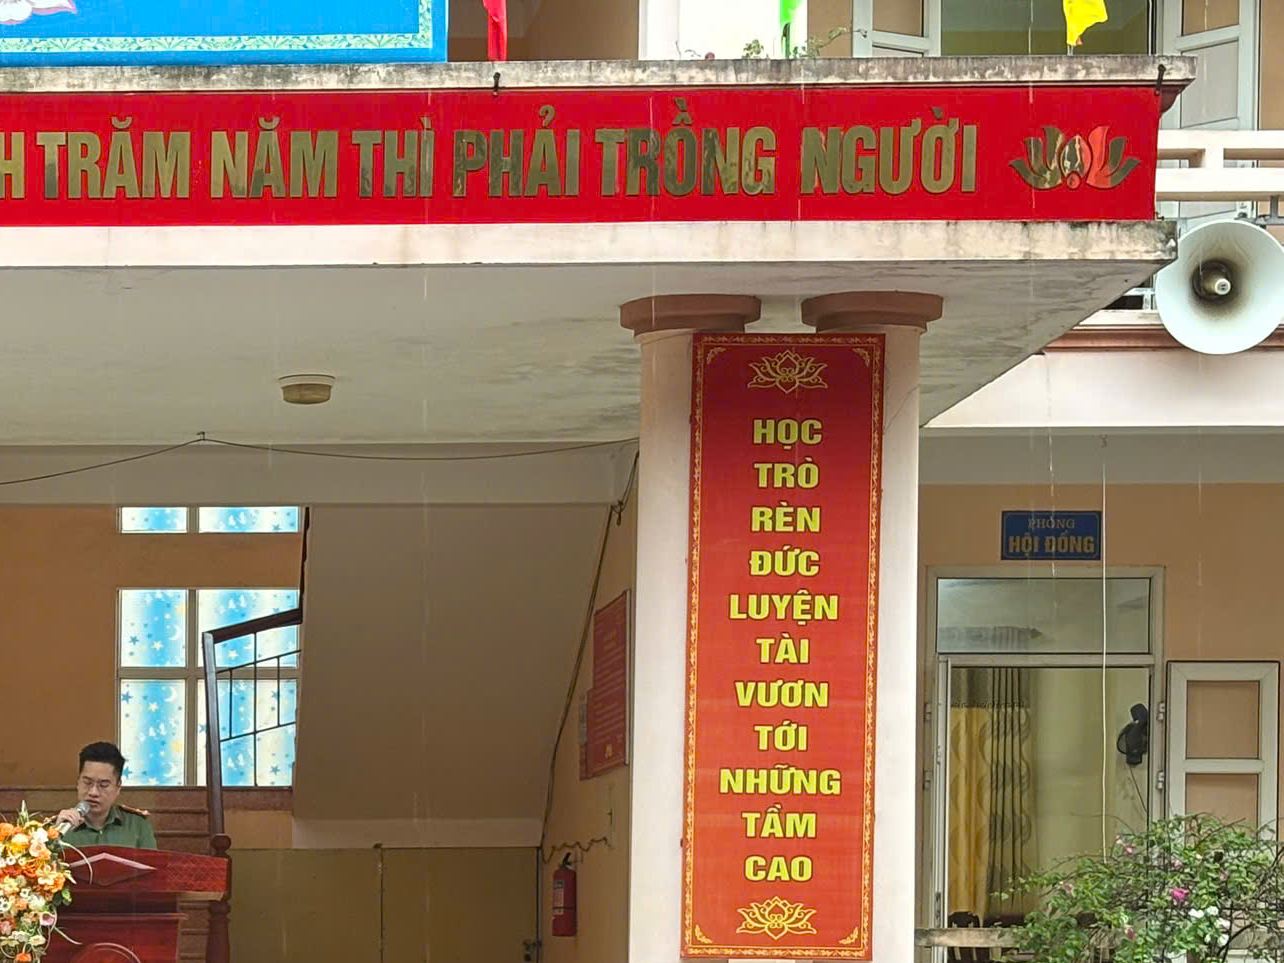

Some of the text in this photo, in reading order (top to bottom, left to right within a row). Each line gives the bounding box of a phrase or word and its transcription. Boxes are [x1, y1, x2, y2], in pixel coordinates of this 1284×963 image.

[36, 116, 191, 199] TRĂM
[211, 116, 338, 198] NĂM
[352, 116, 435, 197] THÌ
[452, 105, 580, 196] PHẢI
[595, 98, 776, 196] TRỒNG
[800, 106, 977, 194] NGƯỜI
[752, 419, 823, 450] HỌC
[753, 457, 820, 489] TRÒ
[750, 501, 822, 533] RÈN
[748, 545, 820, 577] ĐỨC
[728, 589, 839, 625] LUYỆN
[755, 633, 810, 664] TÀI
[734, 679, 829, 708] VƯƠN
[754, 720, 808, 751] TỚI
[719, 764, 841, 795] NHỮNG
[741, 804, 817, 838] TẦM
[744, 856, 813, 882] CAO
